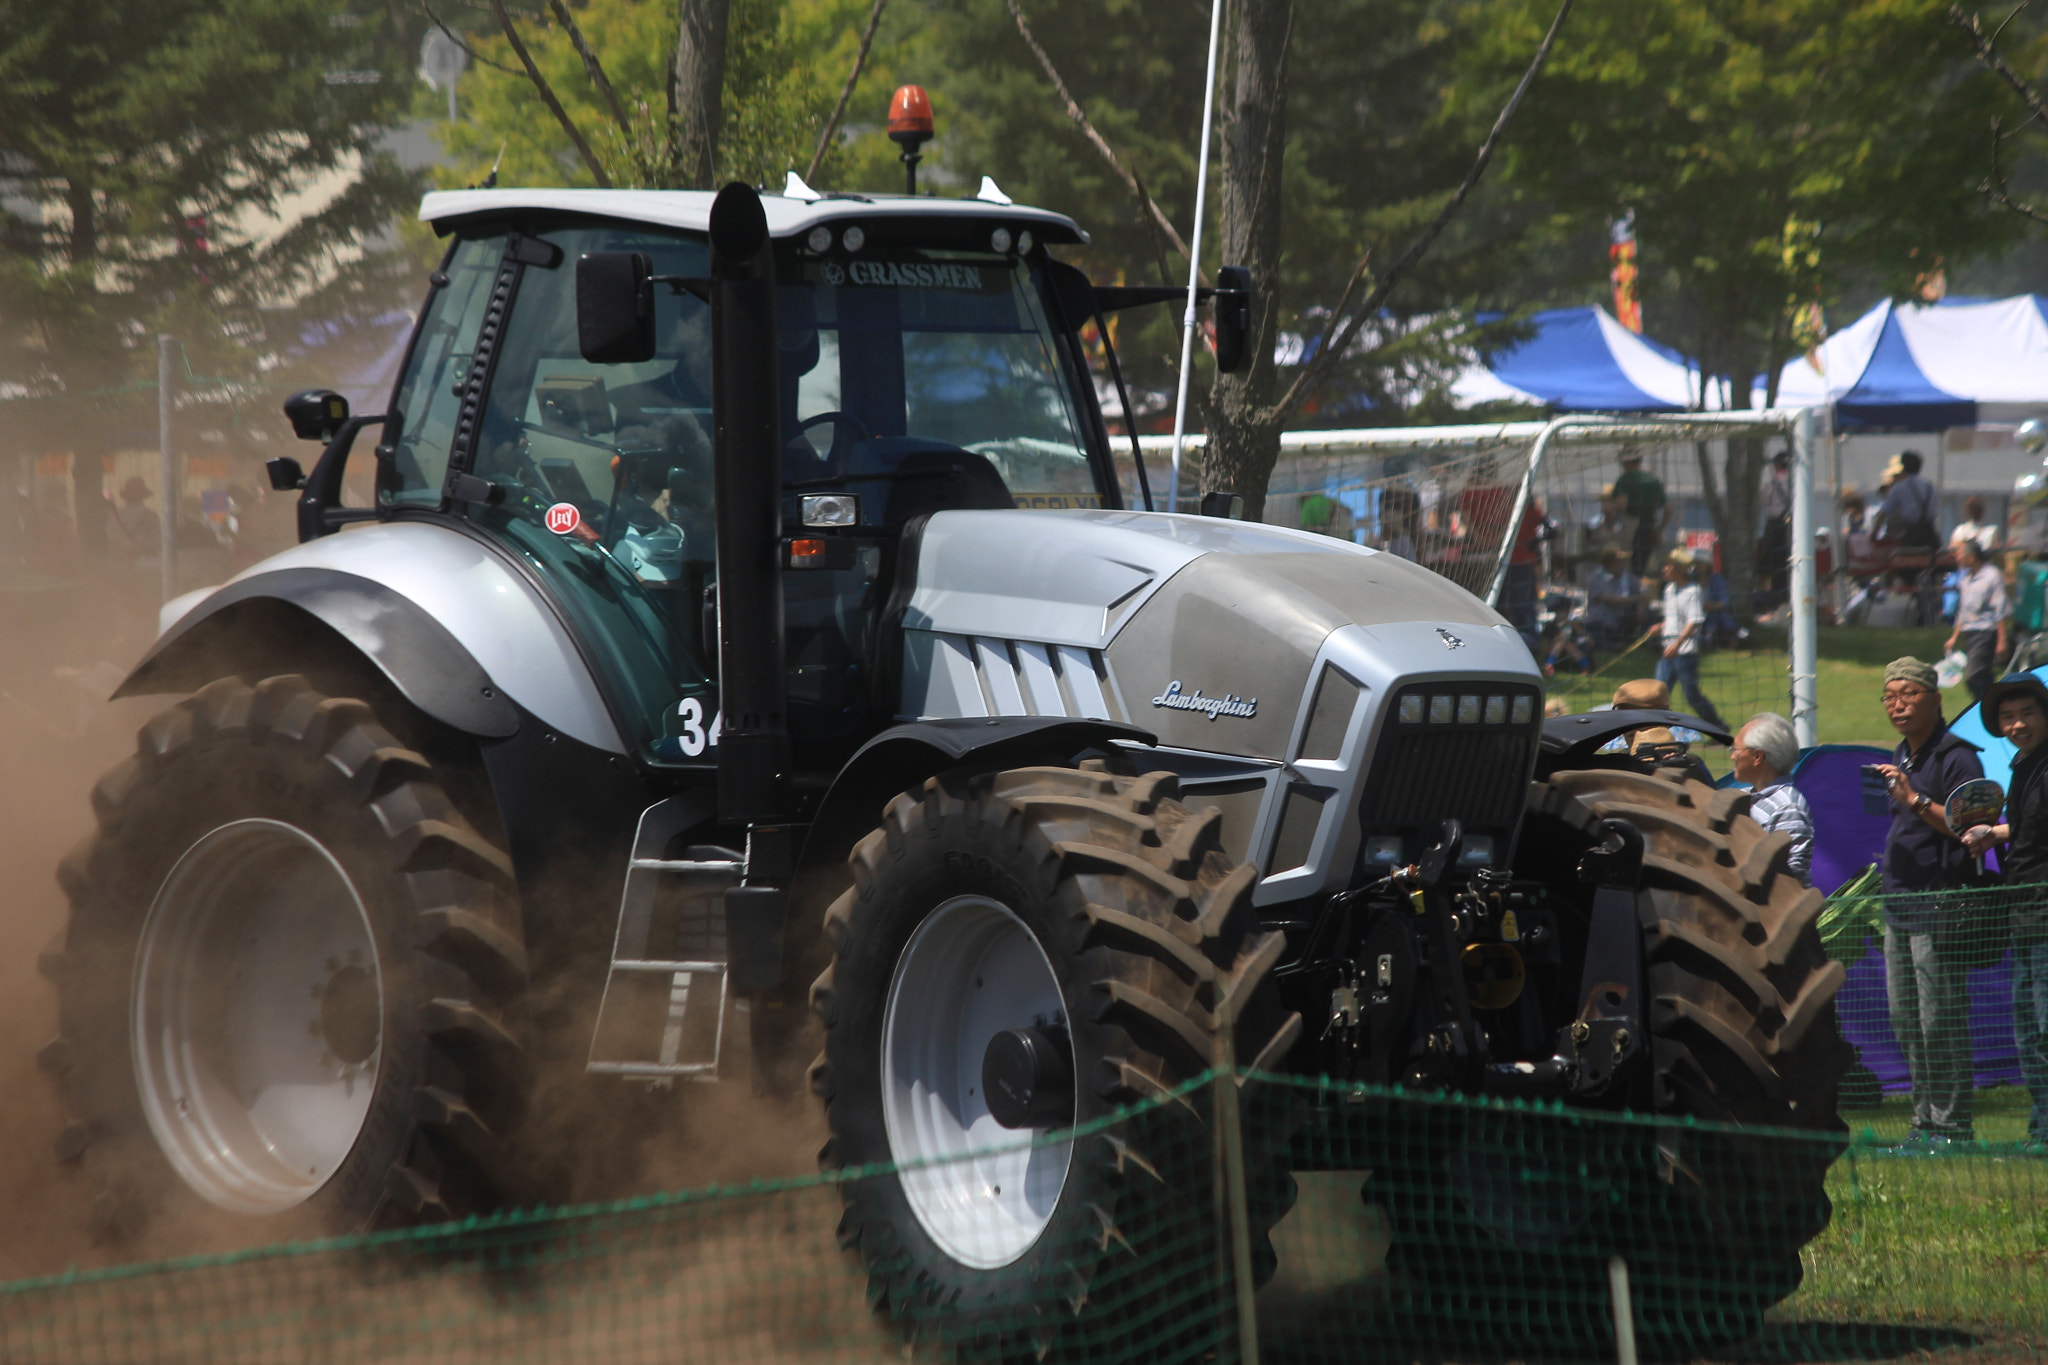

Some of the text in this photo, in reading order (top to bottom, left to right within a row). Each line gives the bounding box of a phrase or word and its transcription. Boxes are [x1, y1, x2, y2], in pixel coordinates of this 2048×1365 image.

[850, 260, 982, 289] GRASSMEN
[551, 508, 573, 529] LELY
[1151, 680, 1257, 720] Lamborghini
